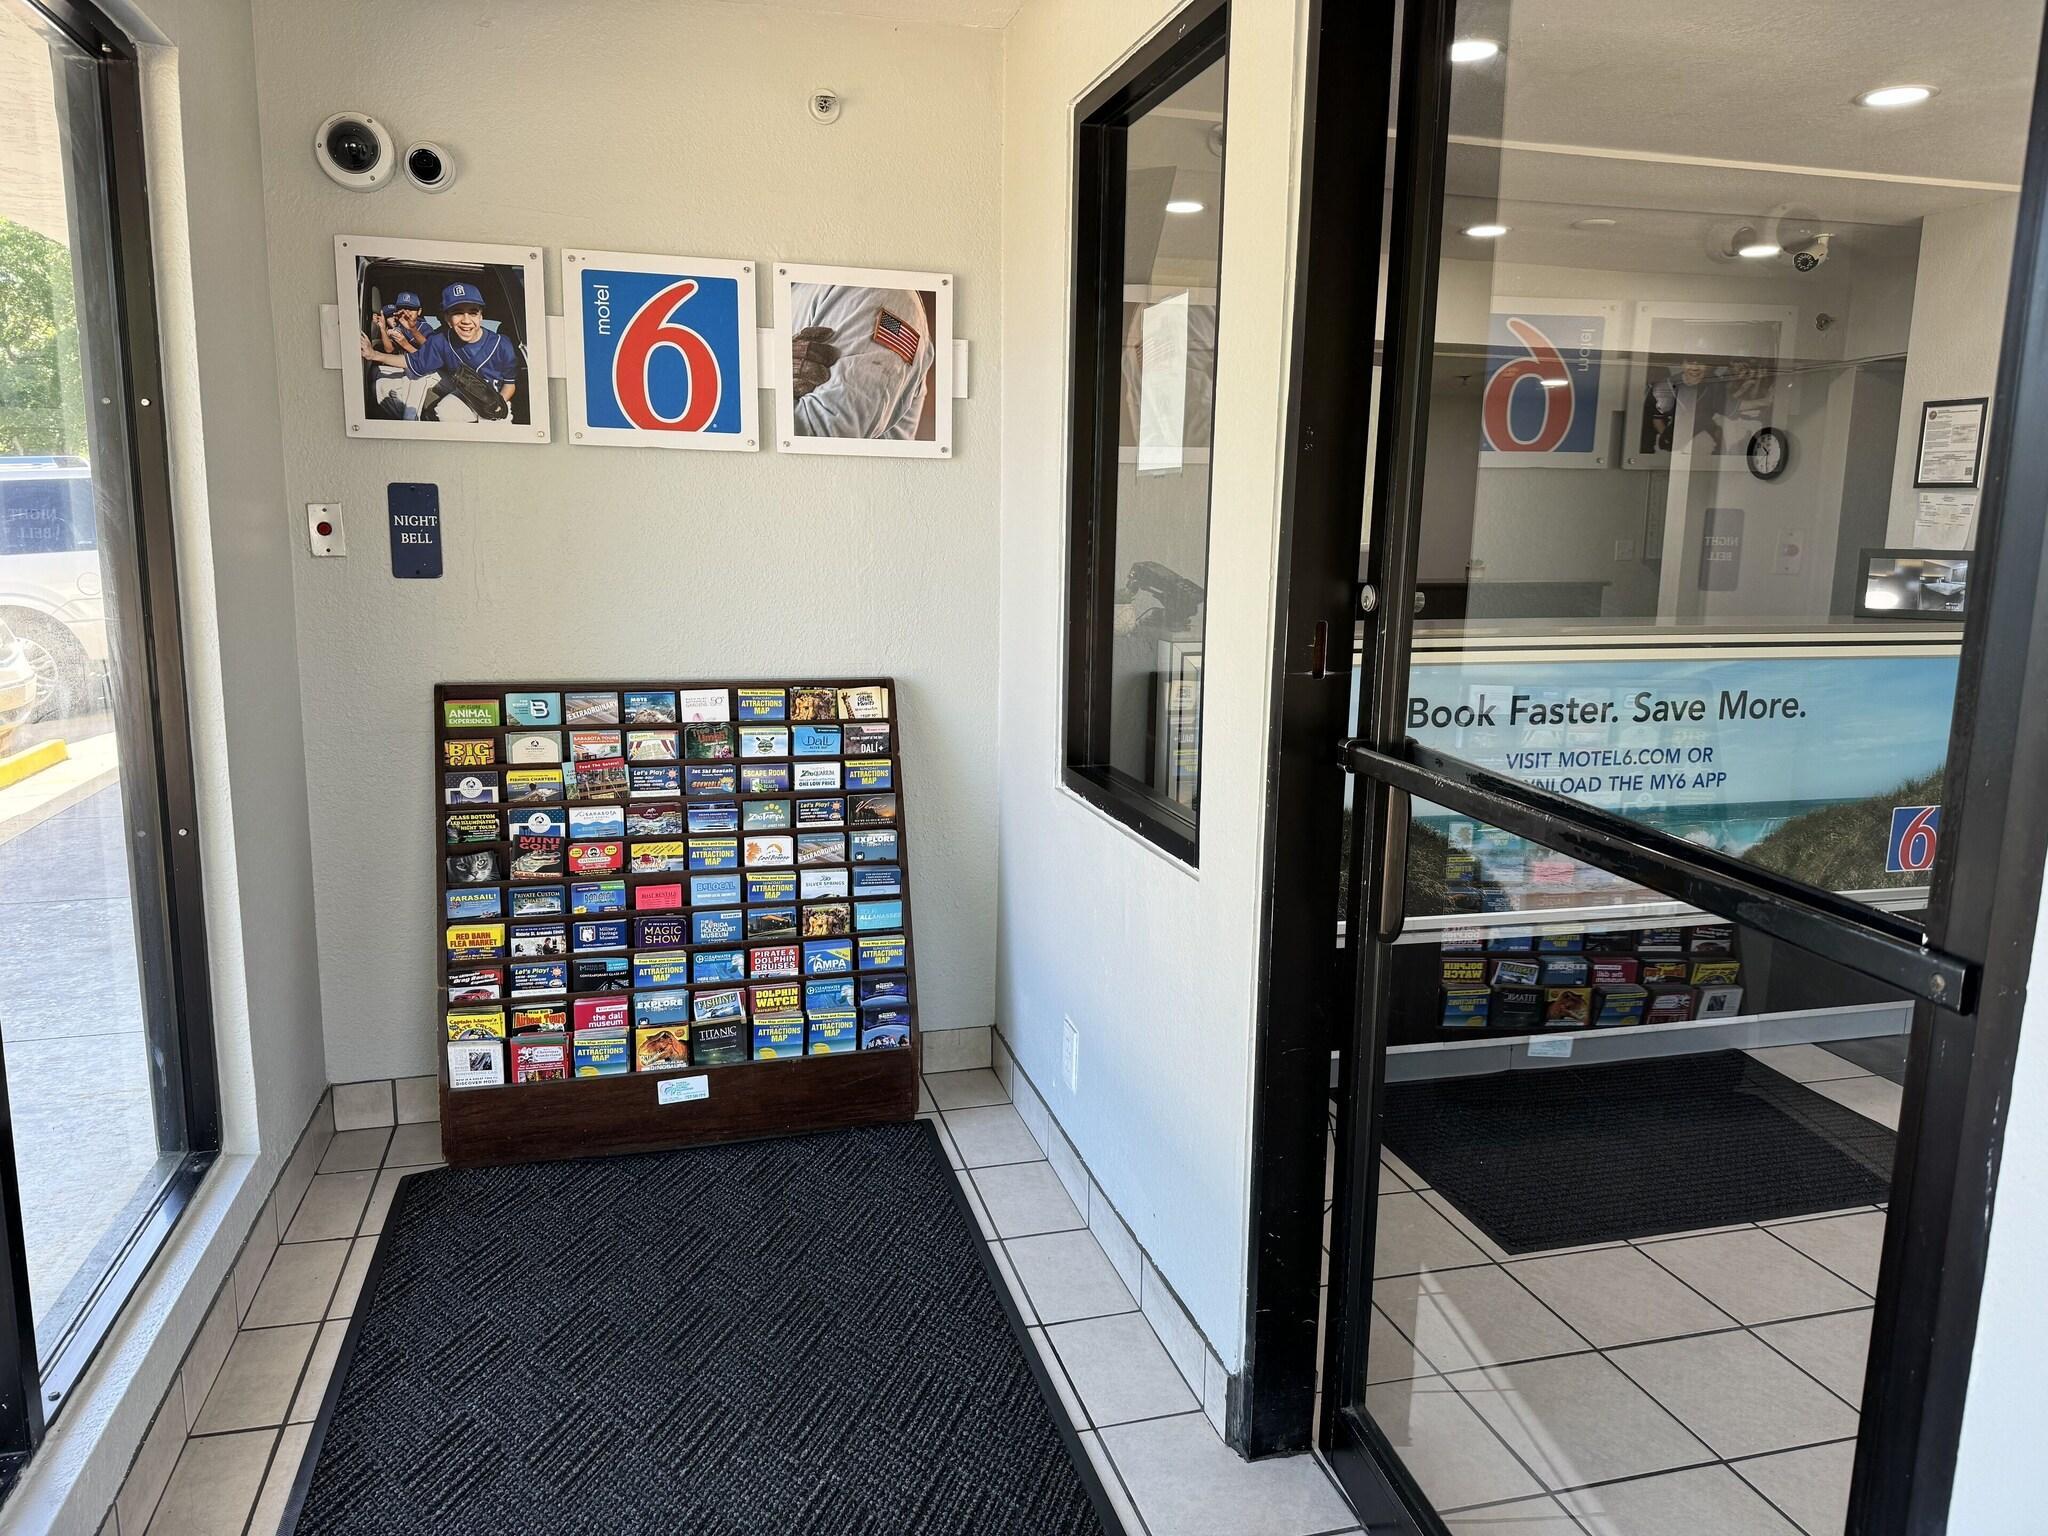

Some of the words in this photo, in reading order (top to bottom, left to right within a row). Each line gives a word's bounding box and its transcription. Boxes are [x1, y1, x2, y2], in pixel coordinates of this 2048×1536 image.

[593, 284, 610, 335] motel
[612, 279, 722, 432] 6
[394, 515, 437, 526] NIGHT
[401, 533, 432, 544] BELL
[449, 710, 491, 718] ANIMAL
[568, 700, 617, 720] EXTRAORDINARY
[1407, 694, 1497, 728] Book
[1510, 695, 1618, 726] Faster.
[1632, 692, 1706, 722] Save
[1719, 690, 1806, 720] More.
[449, 743, 489, 756] BIG
[449, 756, 489, 766] CAT
[1506, 752, 1552, 769] VISIT
[1559, 748, 1681, 768] MOTEL6.COM
[1688, 747, 1713, 763] OR
[850, 770, 888, 778] ATTRACTIONS
[1526, 776, 1601, 793] NLOAD
[1609, 775, 1643, 791] THE
[1650, 773, 1686, 789] MY6
[1692, 772, 1727, 788] APP
[520, 836, 560, 844] MINI
[855, 835, 895, 843] EXPLORE
[1899, 806, 1937, 870] 6
[645, 926, 682, 935] MAGIC
[645, 935, 681, 944] SHOW
[755, 956, 795, 964] DOLPHIN
[755, 962, 795, 970] CRUISES
[640, 967, 683, 976] ATTRACTIONS
[653, 974, 670, 982] MAP
[756, 988, 798, 998] DOLPHIN
[637, 999, 683, 1009] EXPLORE
[698, 994, 736, 1009] FISHING
[756, 996, 798, 1008] WATCH
[516, 1014, 542, 1027] Airboat
[544, 1013, 566, 1024] Tours
[589, 1020, 623, 1028] museum
[758, 1027, 801, 1036] ATTRACTIONS
[812, 1022, 853, 1031] ATTRACTIONS
[699, 1026, 736, 1039] TITANIC
[824, 1029, 840, 1037] MAP
[578, 1048, 623, 1056] ATTRACTIONS
